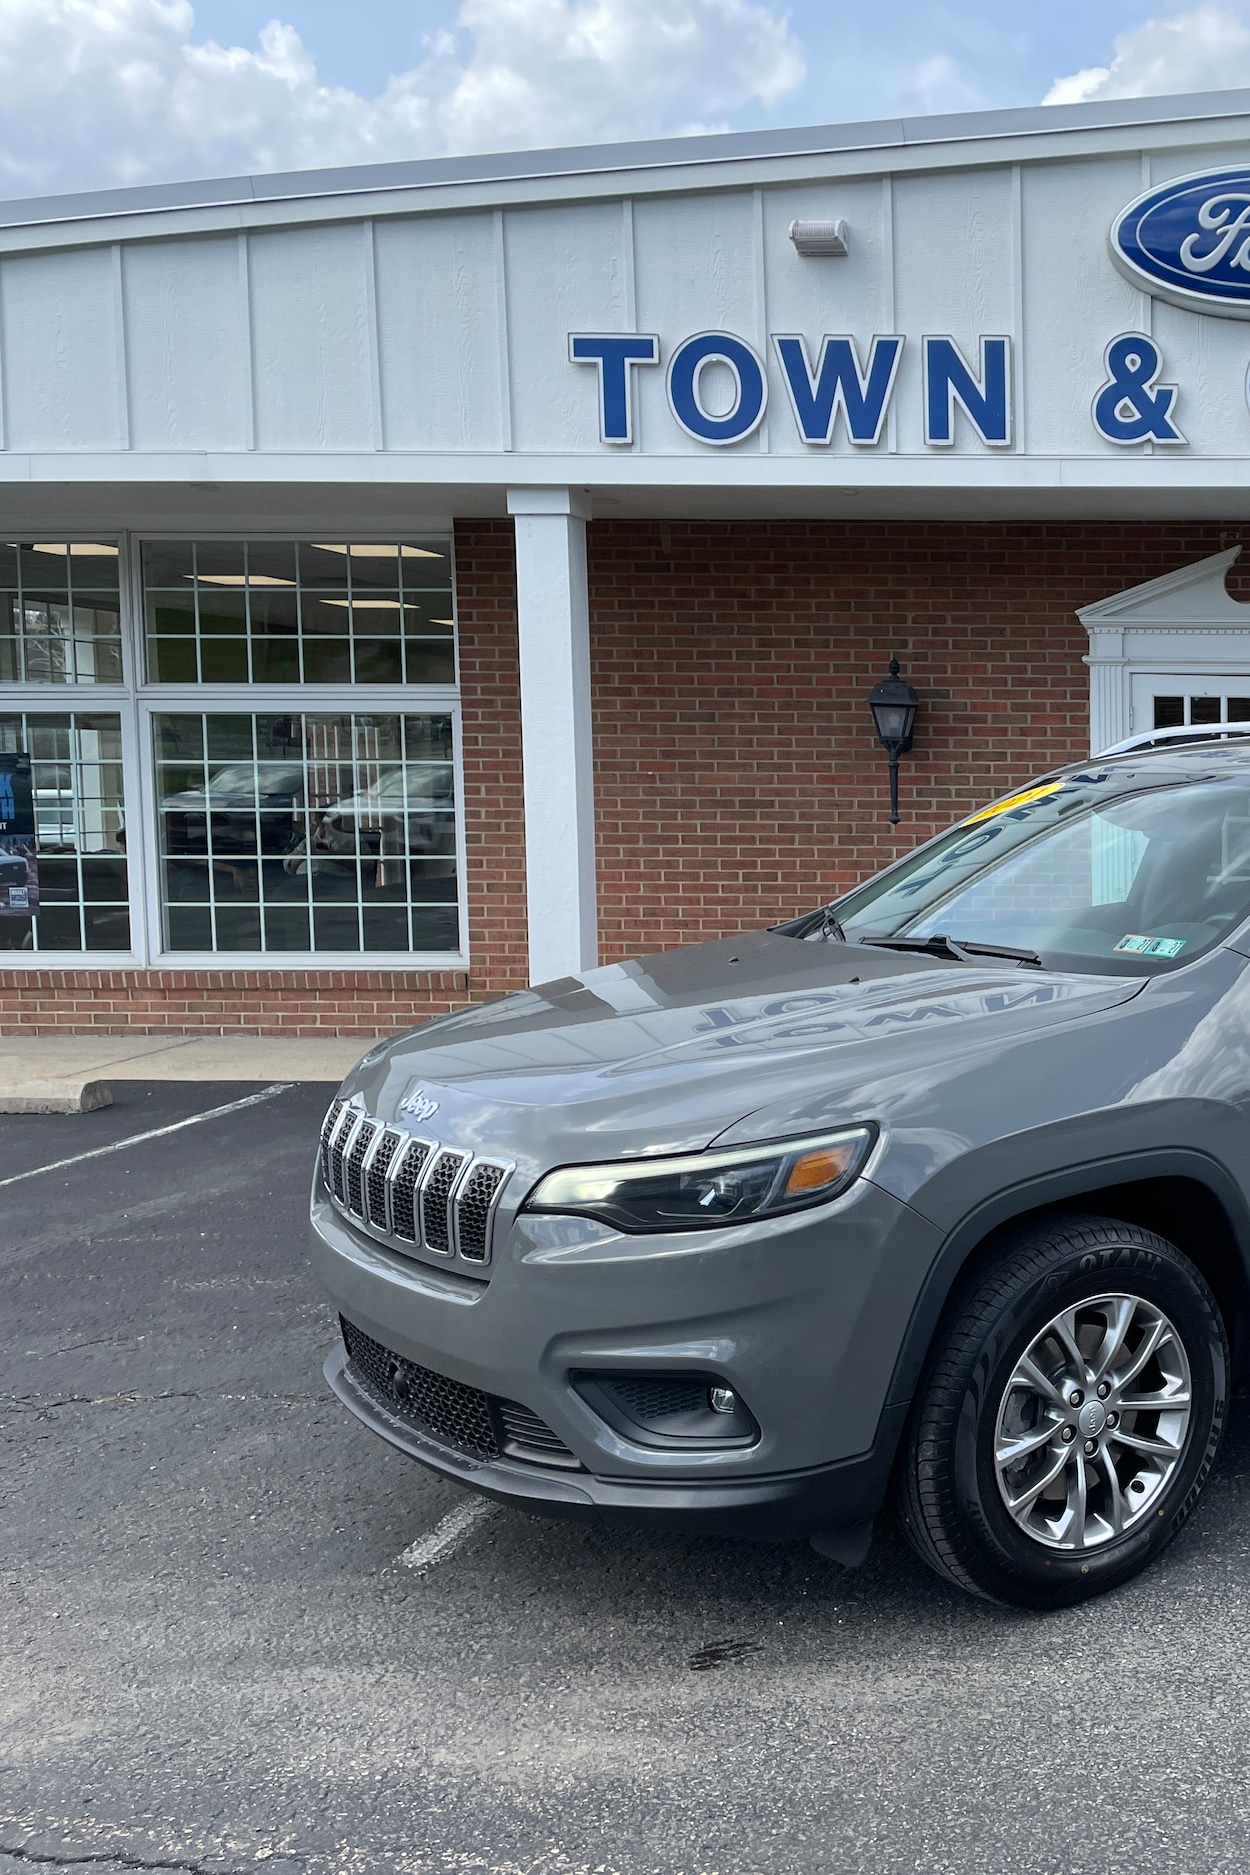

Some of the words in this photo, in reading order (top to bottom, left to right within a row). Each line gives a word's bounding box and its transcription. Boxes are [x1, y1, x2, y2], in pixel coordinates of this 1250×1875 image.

[569, 331, 1012, 445] TOWN
[1091, 331, 1190, 445] &
[400, 1088, 440, 1122] Jeep
[1079, 1249, 1162, 1272] OTANI
